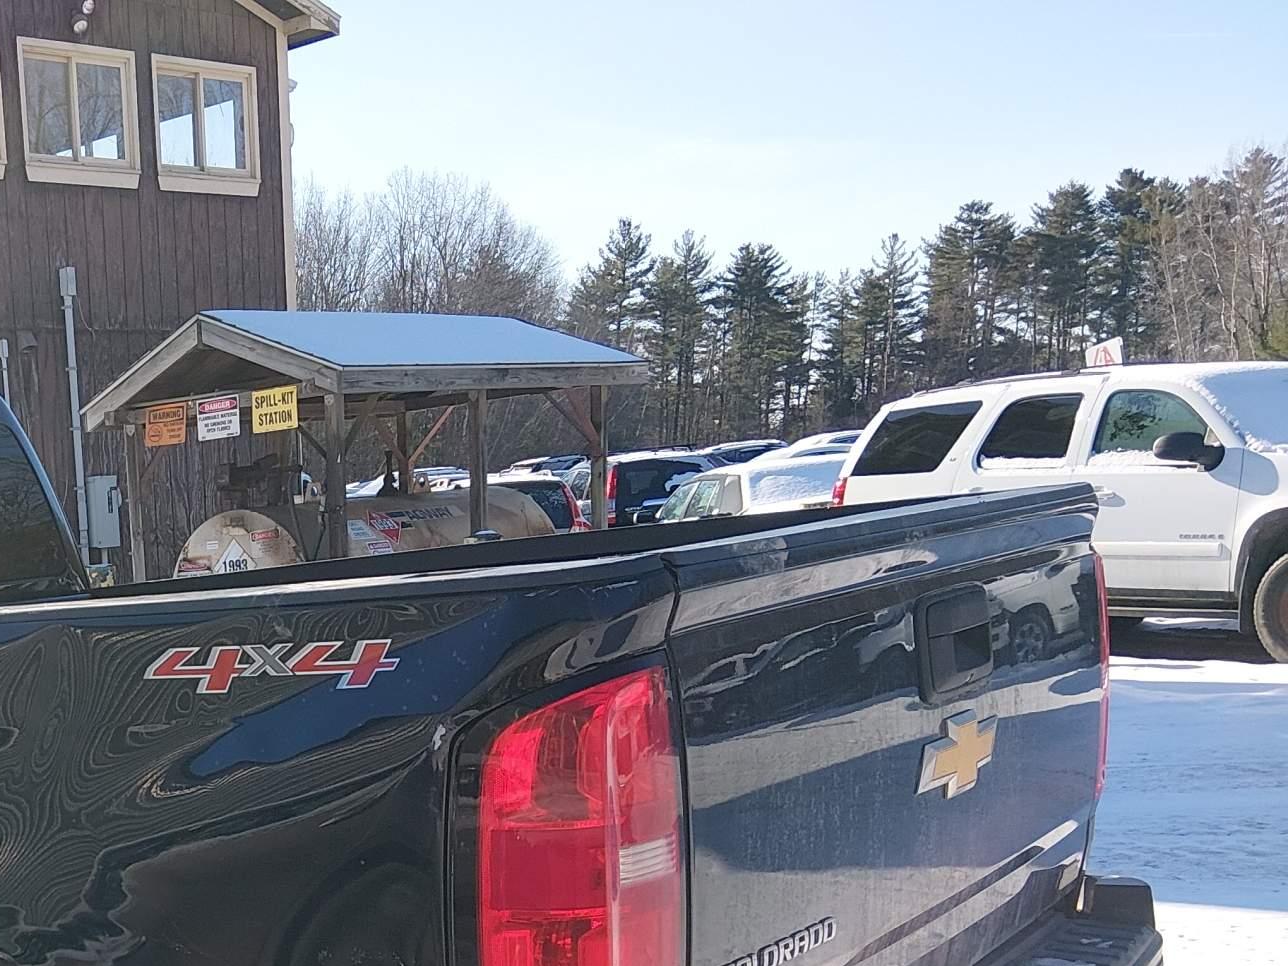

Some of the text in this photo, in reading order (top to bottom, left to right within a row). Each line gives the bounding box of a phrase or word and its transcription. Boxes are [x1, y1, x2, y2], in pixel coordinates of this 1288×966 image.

[204, 400, 231, 411] DANGER
[254, 391, 294, 410] SPILL-KIT
[152, 408, 181, 421] WARNING
[258, 409, 293, 427] STATION
[403, 506, 453, 521] AGWAY
[222, 559, 249, 573] 1993
